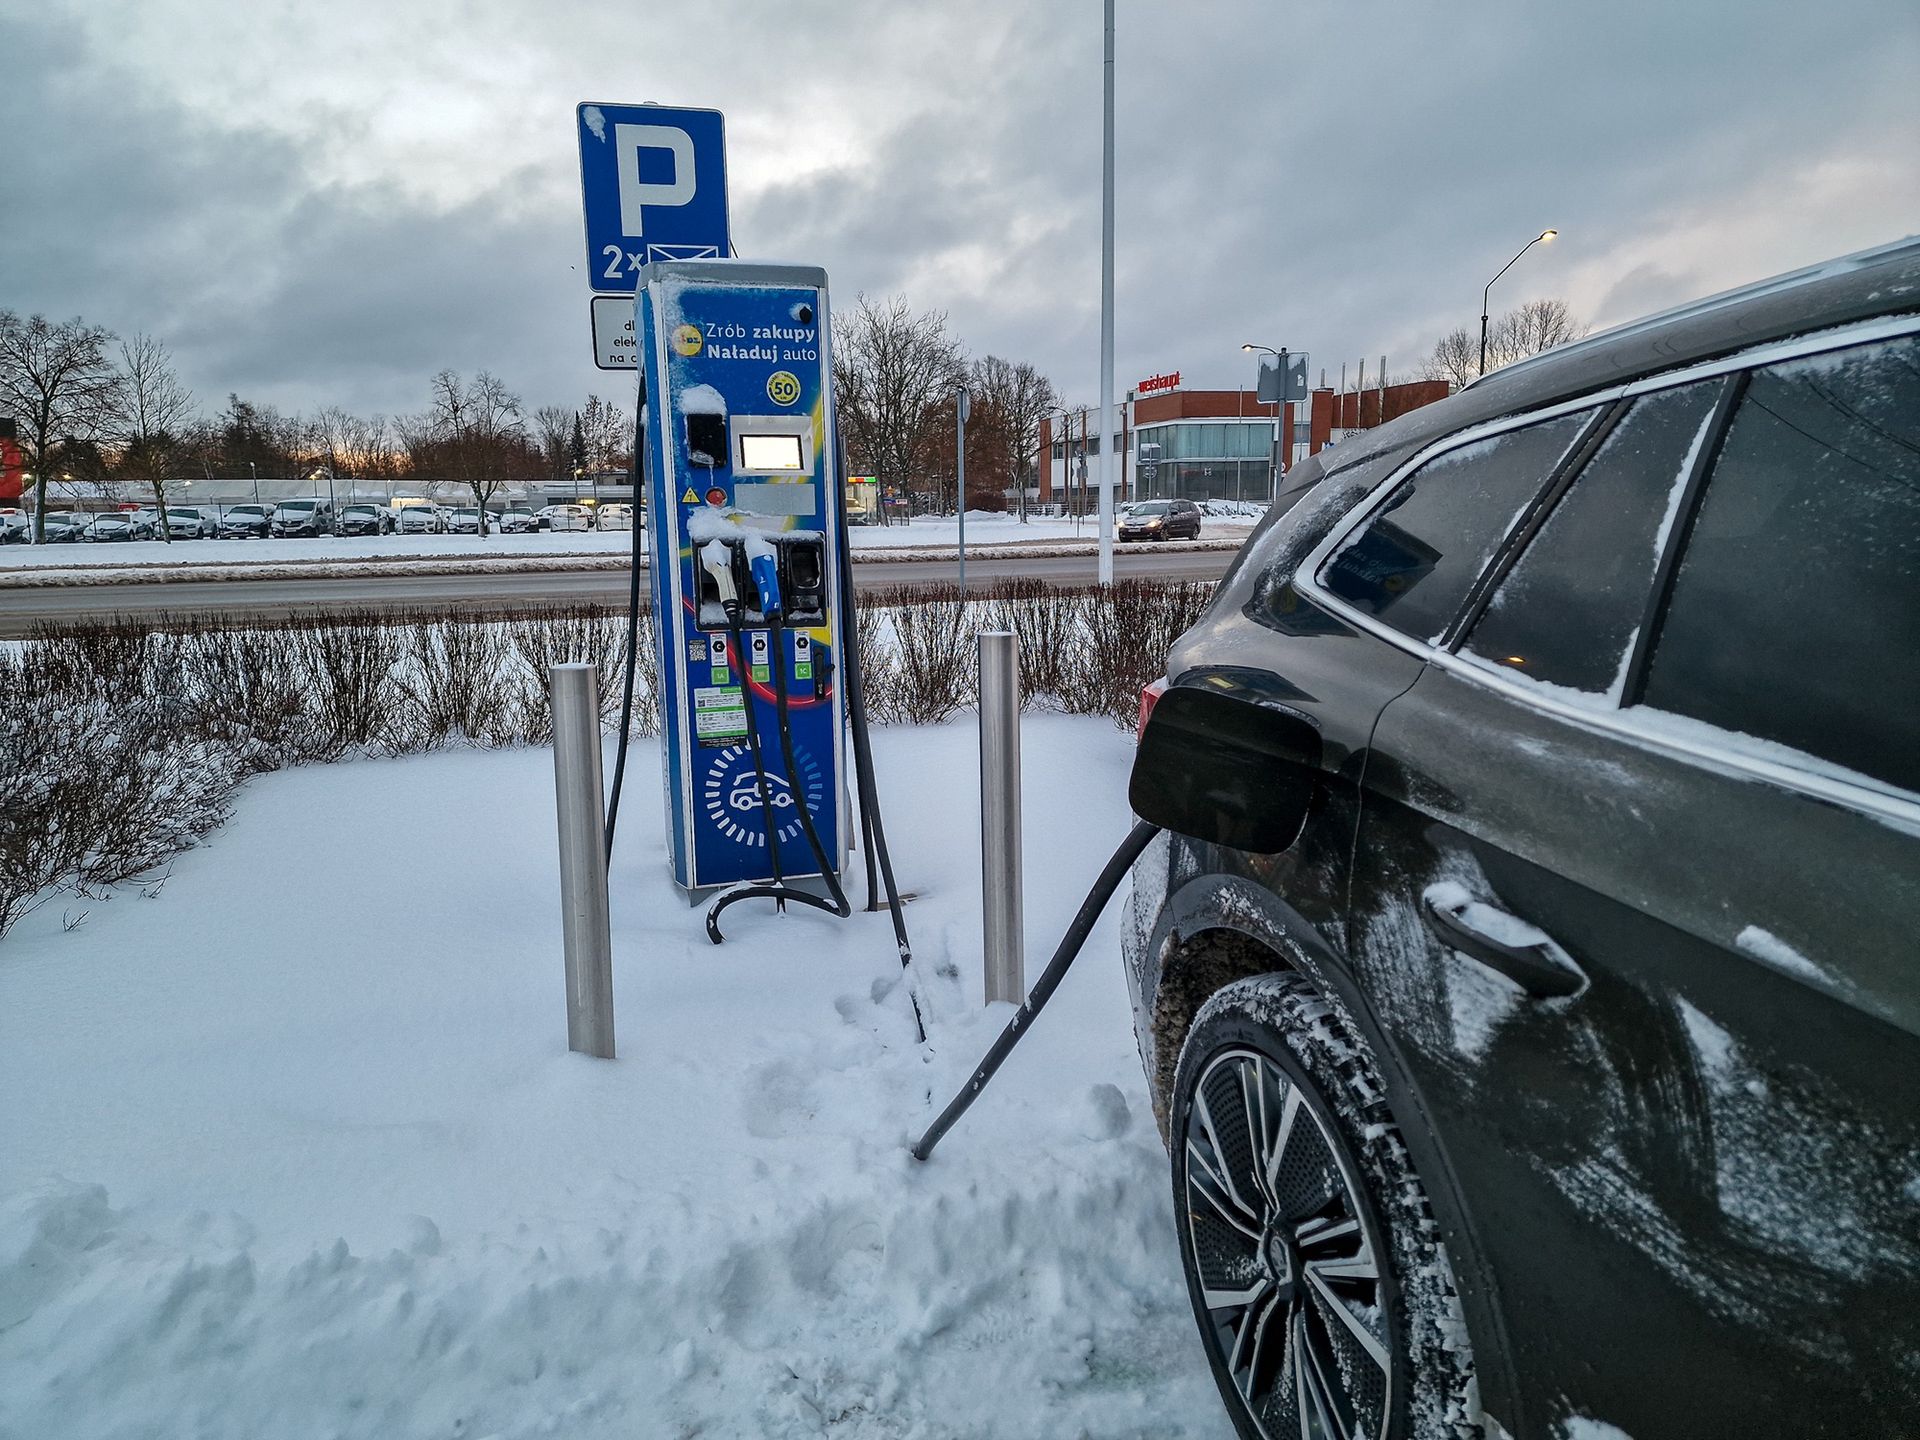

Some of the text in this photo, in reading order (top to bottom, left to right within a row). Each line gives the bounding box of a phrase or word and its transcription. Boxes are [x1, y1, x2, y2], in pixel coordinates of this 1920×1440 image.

[615, 123, 696, 237] P
[624, 320, 635, 331] dl
[706, 323, 815, 343] Zrób zakupy
[613, 336, 637, 347] elek
[609, 355, 624, 363] na
[707, 344, 817, 363] Naładuj auto
[774, 382, 794, 396] 50
